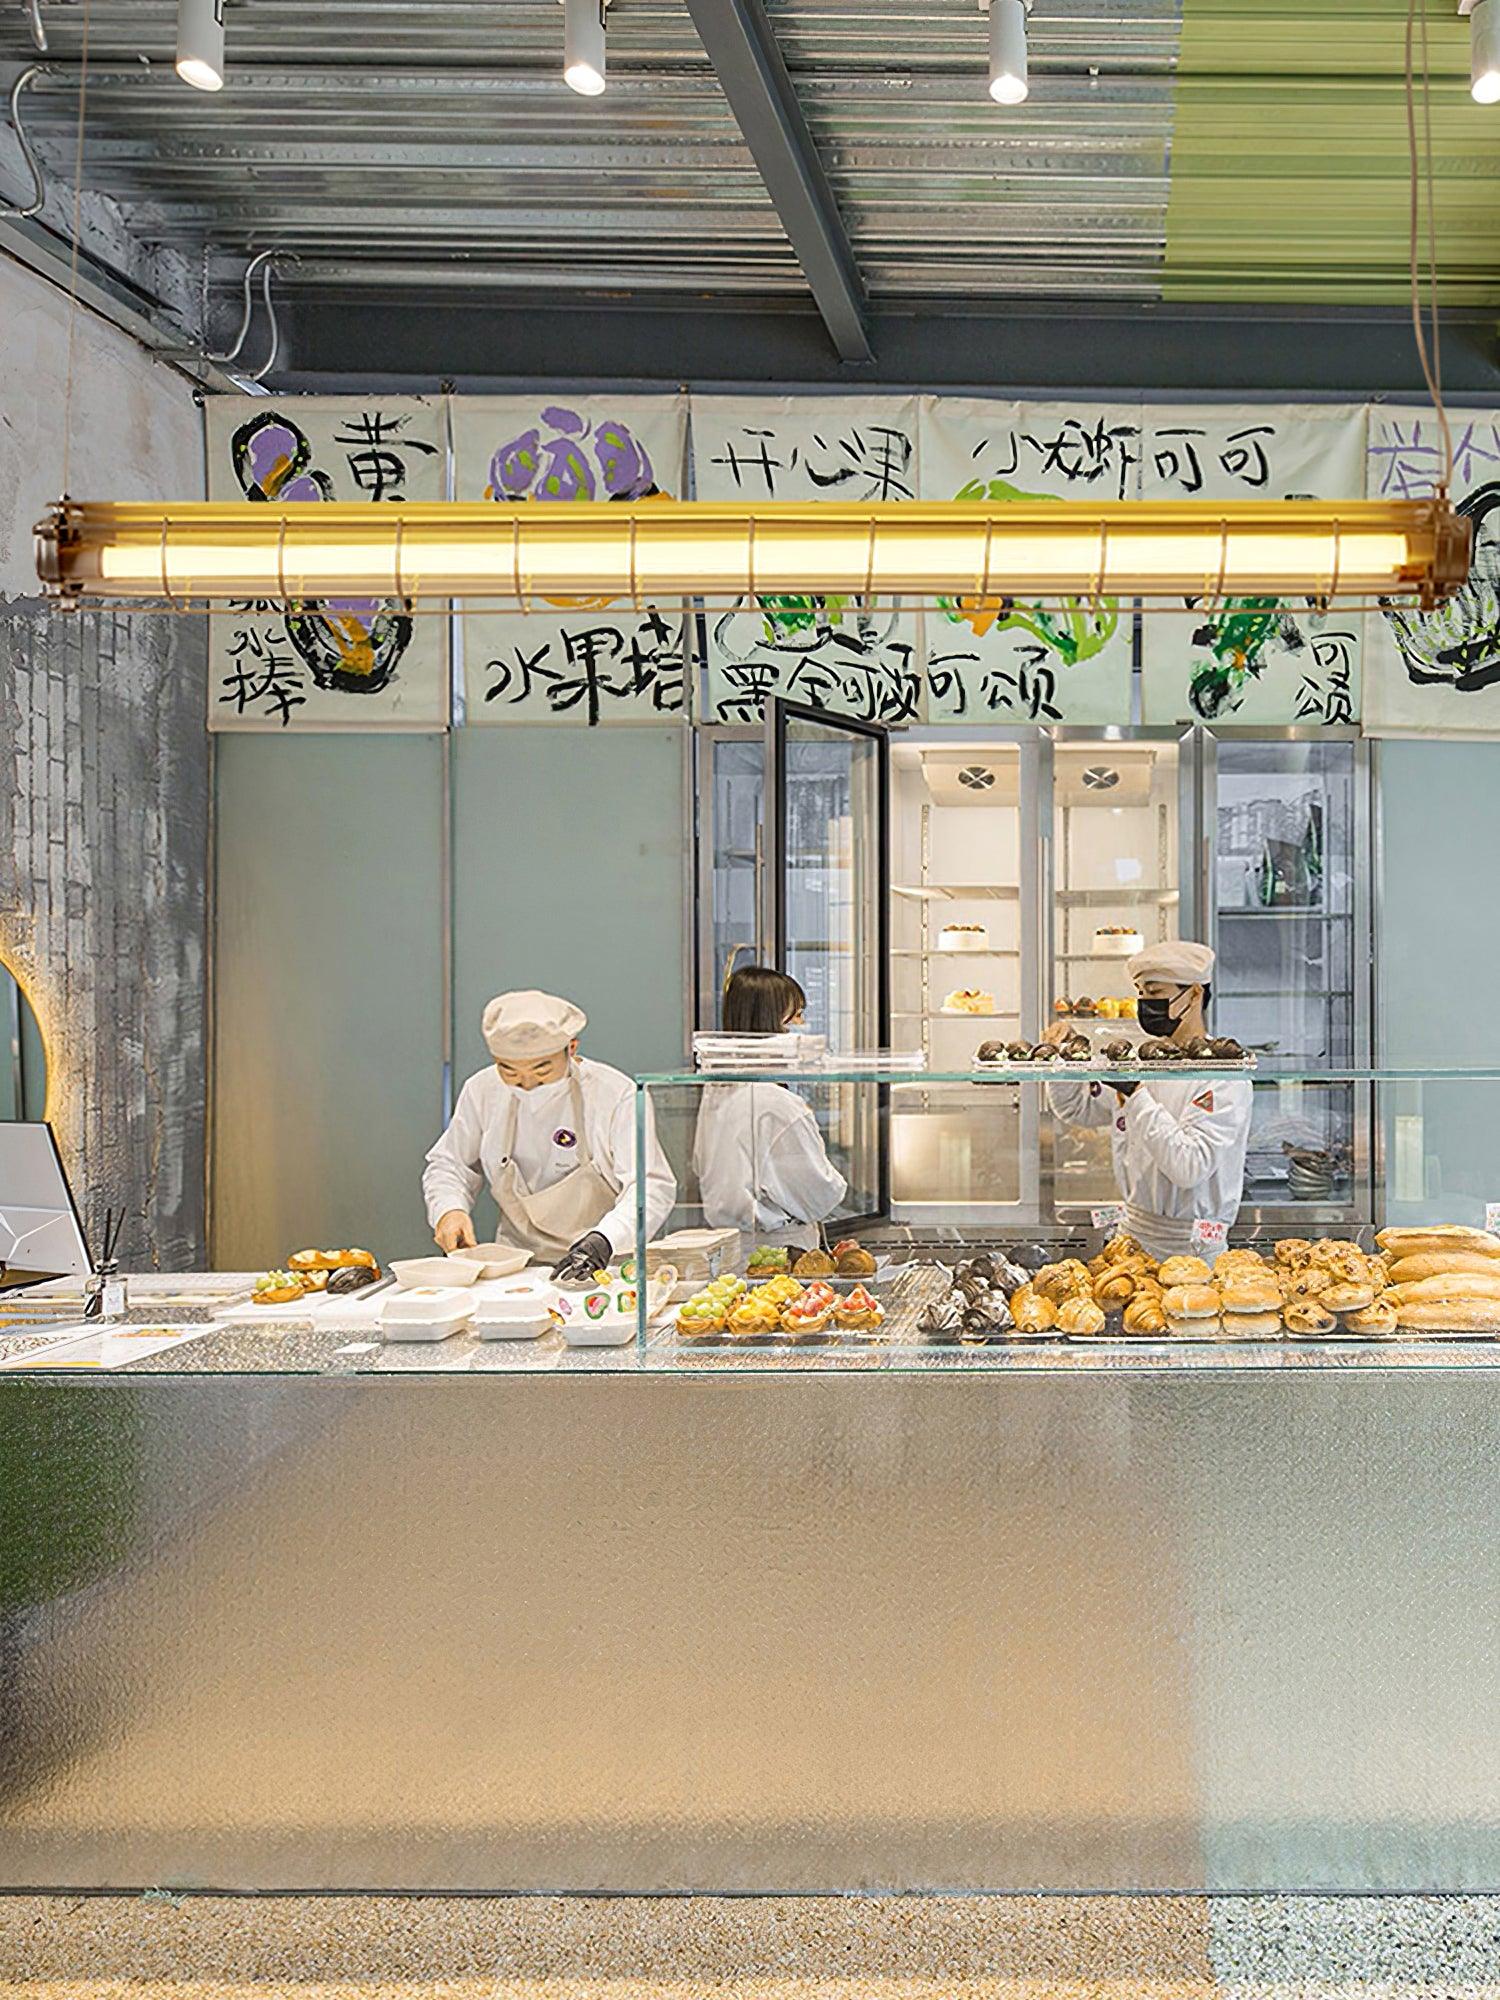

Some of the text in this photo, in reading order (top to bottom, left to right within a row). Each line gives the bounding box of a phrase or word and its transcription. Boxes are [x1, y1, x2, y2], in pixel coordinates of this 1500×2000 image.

[711, 427, 914, 501] 开心果
[485, 605, 700, 726] 水果塔
